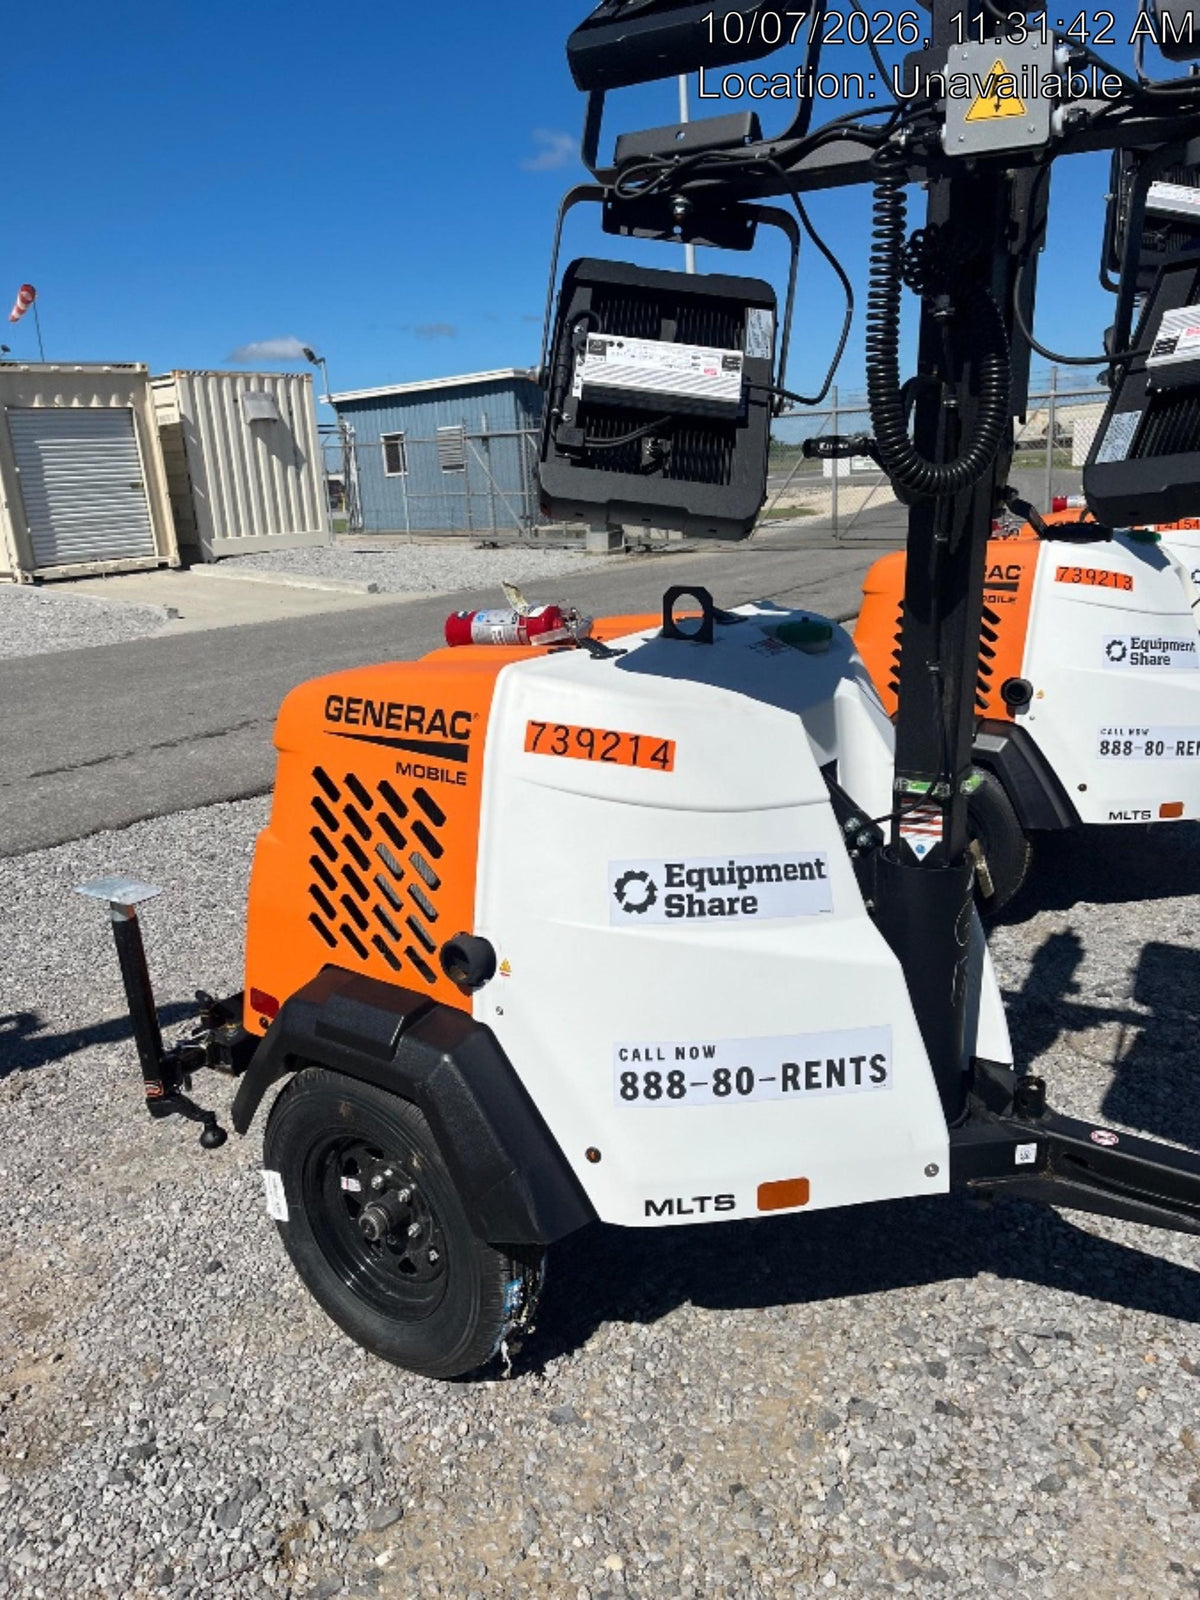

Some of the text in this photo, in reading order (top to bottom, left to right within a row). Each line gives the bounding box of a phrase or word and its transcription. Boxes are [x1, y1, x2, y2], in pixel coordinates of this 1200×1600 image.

[1058, 567, 1132, 591] 739213
[1130, 637, 1196, 653] Equipment
[1130, 652, 1171, 666] Share
[324, 694, 472, 740] GENERAC
[531, 721, 669, 769] 739214
[396, 762, 467, 786] MOBILE
[1109, 810, 1151, 820] MLTS
[664, 858, 827, 892] Equipment
[664, 893, 758, 918] Share
[619, 1045, 716, 1062] CALL NOW
[619, 1053, 888, 1101] 888-80-RENTS
[644, 1194, 736, 1217] MLTS
